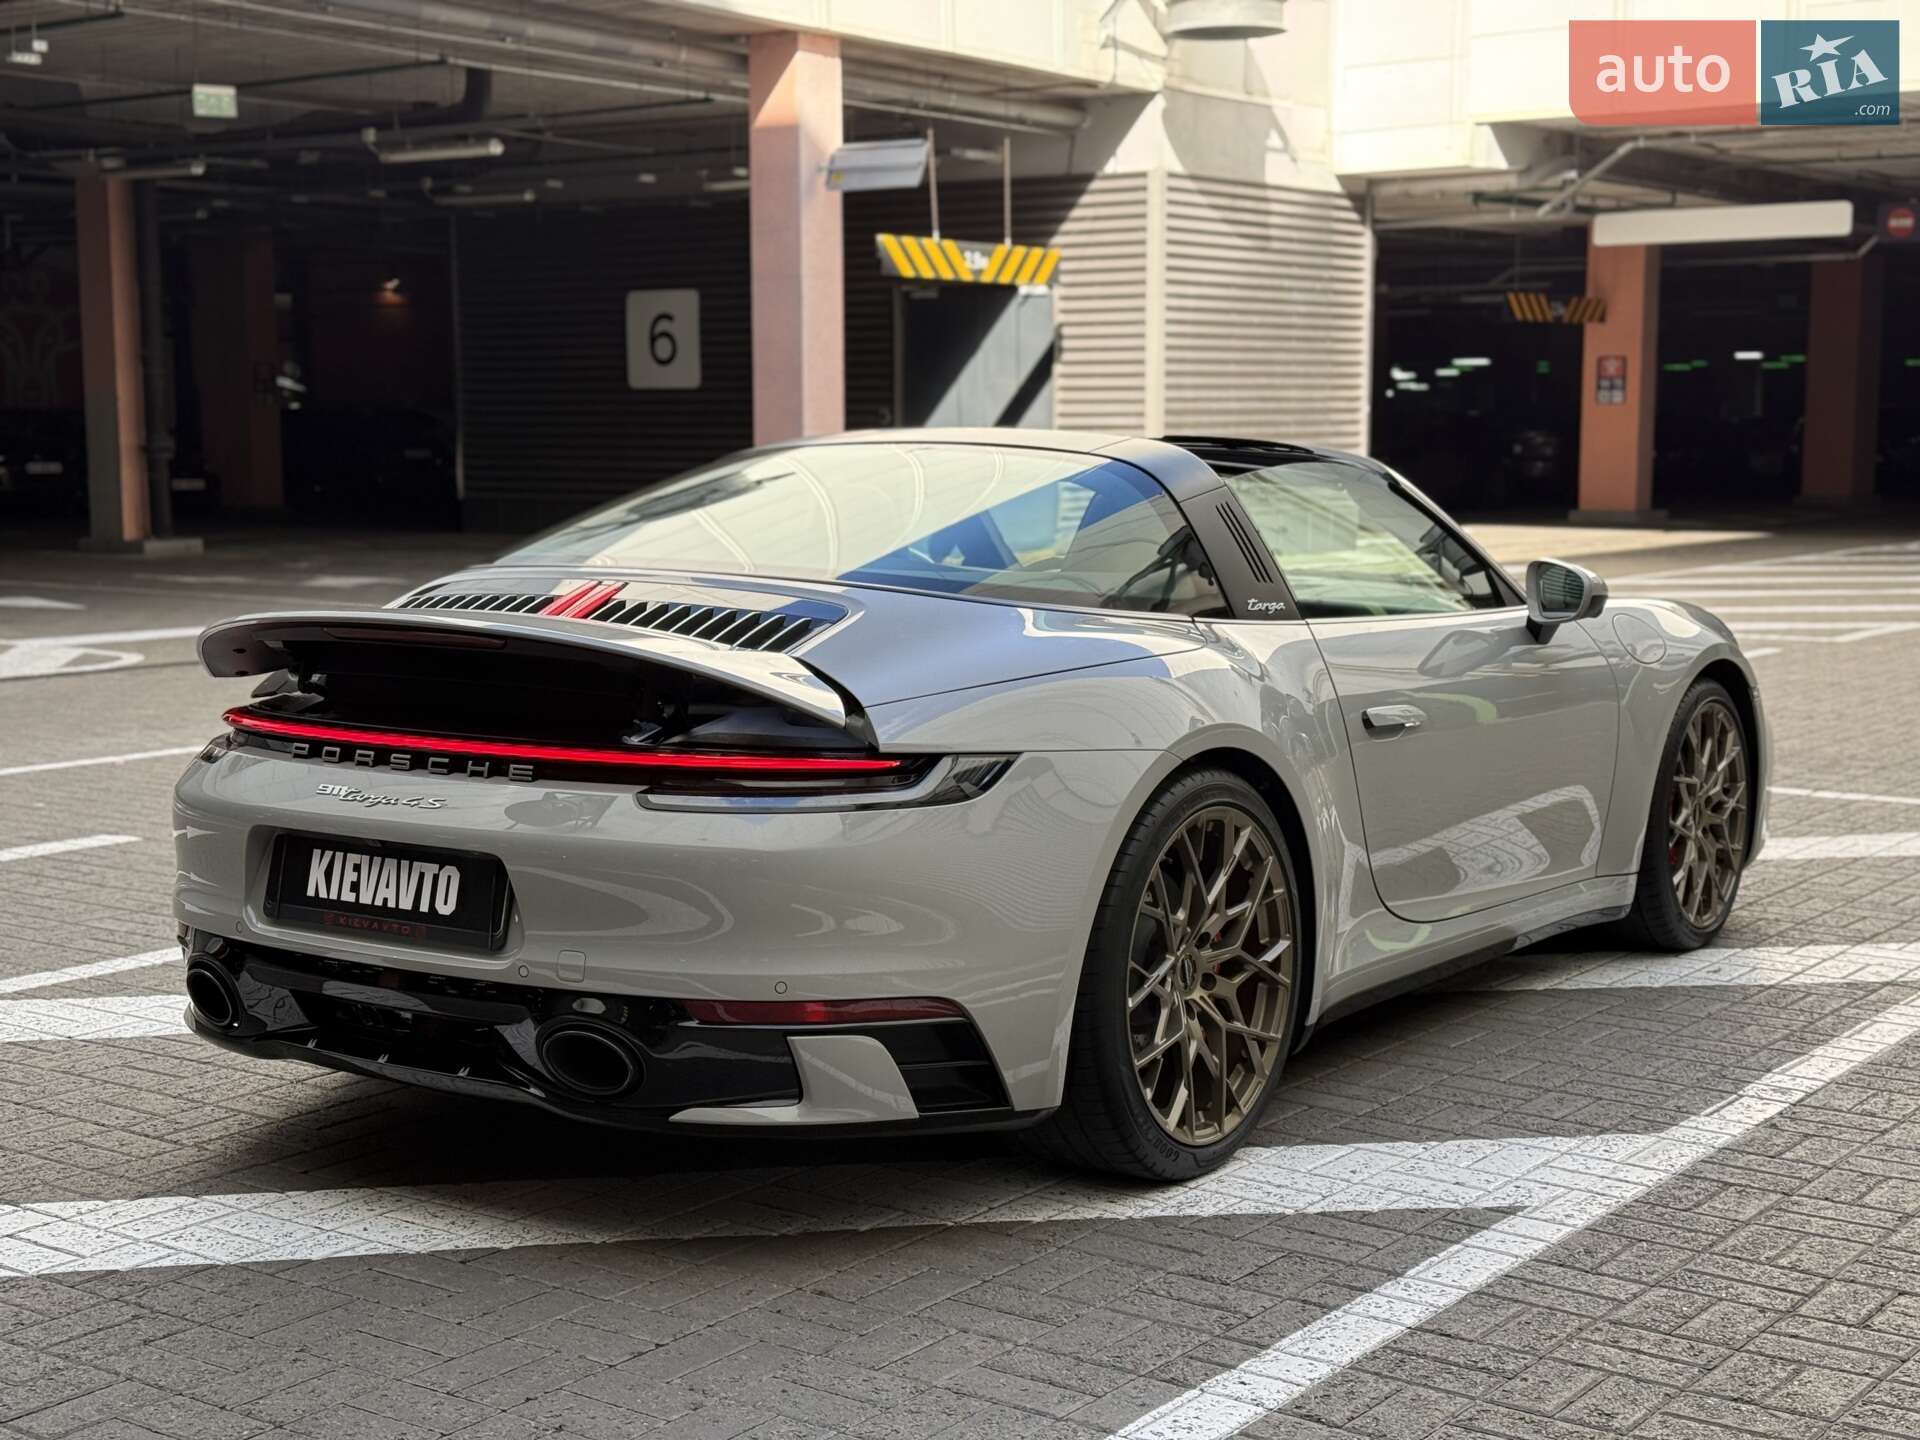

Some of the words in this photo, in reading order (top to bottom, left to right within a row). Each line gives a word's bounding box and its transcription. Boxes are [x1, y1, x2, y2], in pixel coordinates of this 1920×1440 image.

[649, 313, 677, 367] 6
[292, 742, 535, 782] PORSCHE
[306, 848, 461, 916] KIEVAVTO
